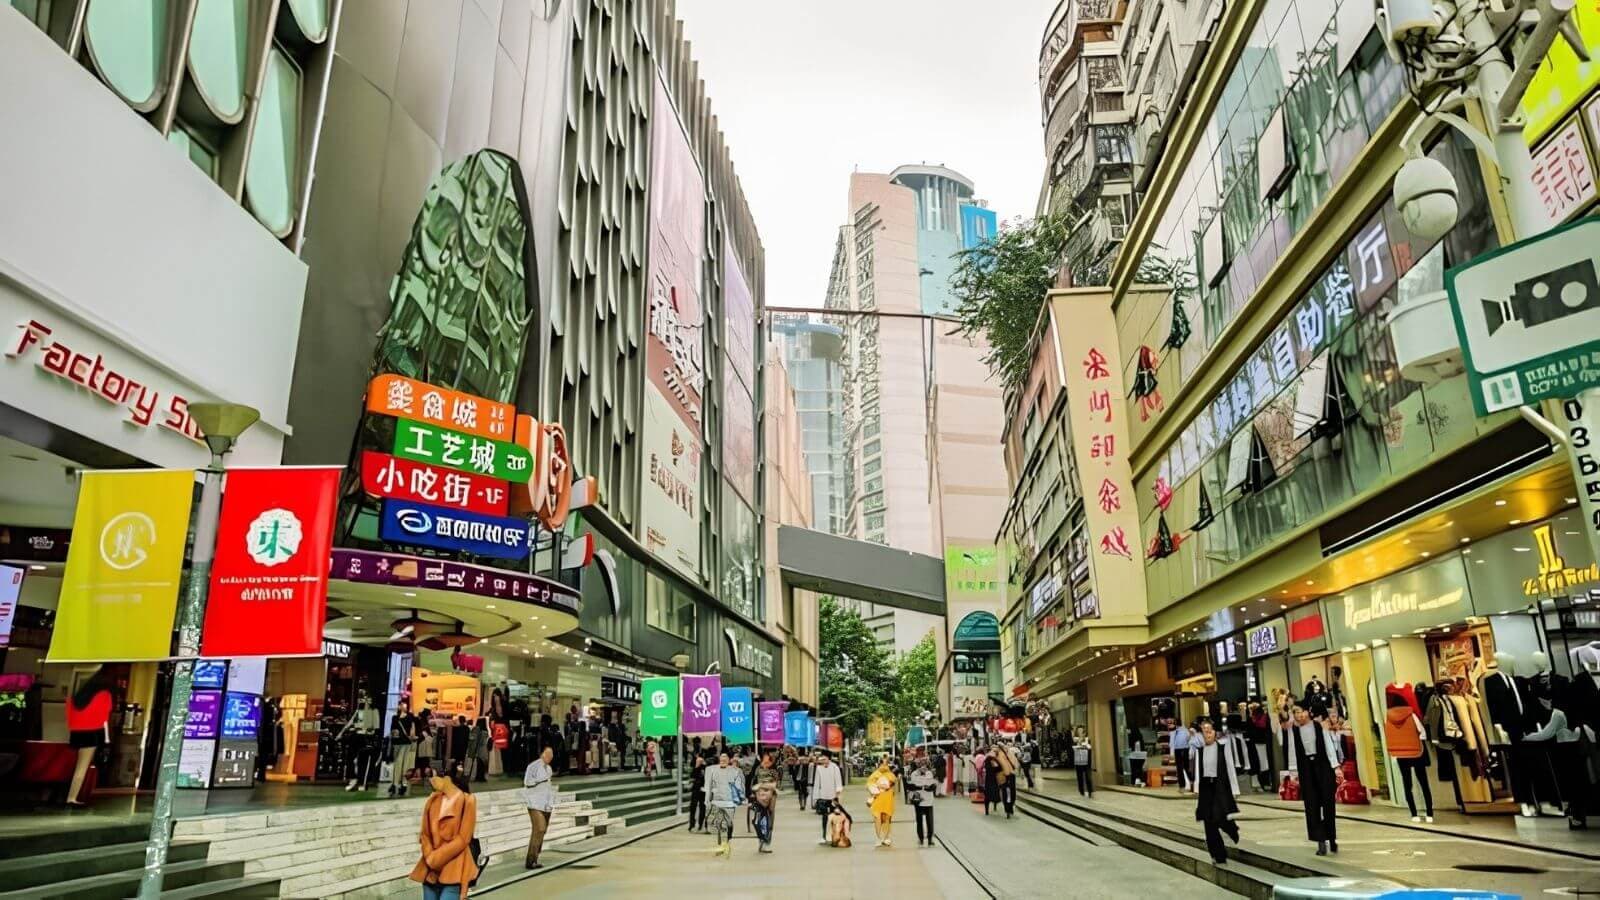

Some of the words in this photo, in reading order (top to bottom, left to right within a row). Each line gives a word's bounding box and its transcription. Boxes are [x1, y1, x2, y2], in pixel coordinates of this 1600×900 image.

[17, 320, 158, 426] Factory
[376, 458, 471, 506] 小吃街
